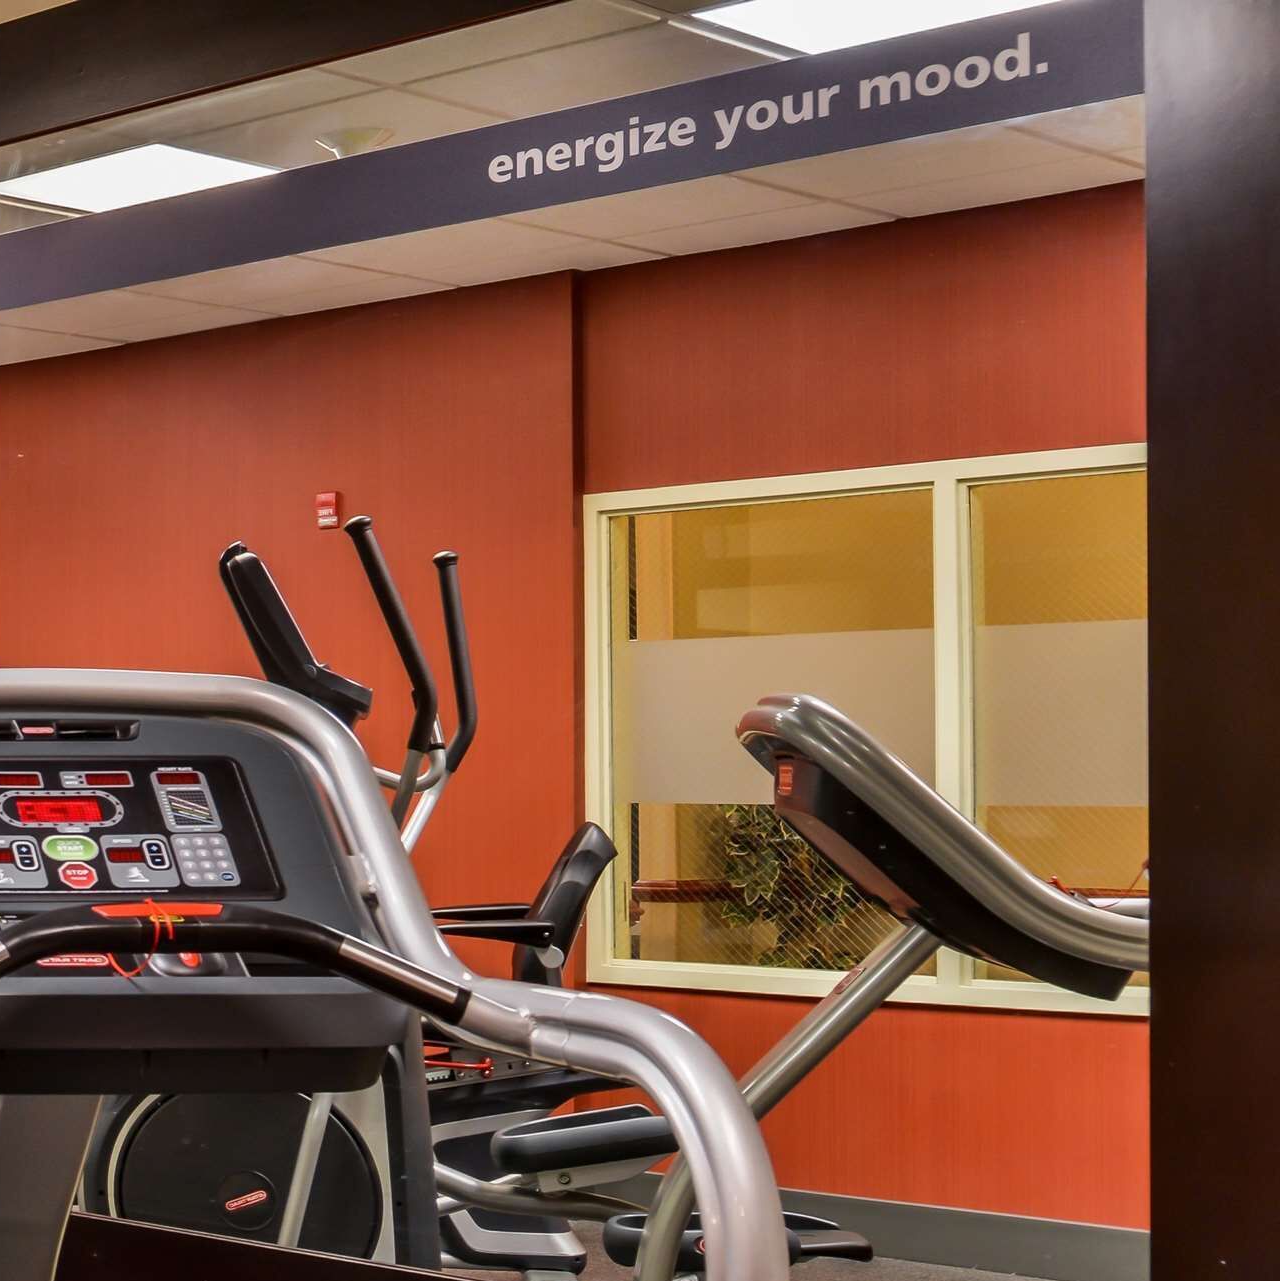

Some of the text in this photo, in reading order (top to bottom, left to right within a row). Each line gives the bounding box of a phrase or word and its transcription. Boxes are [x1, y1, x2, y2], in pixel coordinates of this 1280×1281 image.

[488, 32, 1049, 184] energize your mood.
